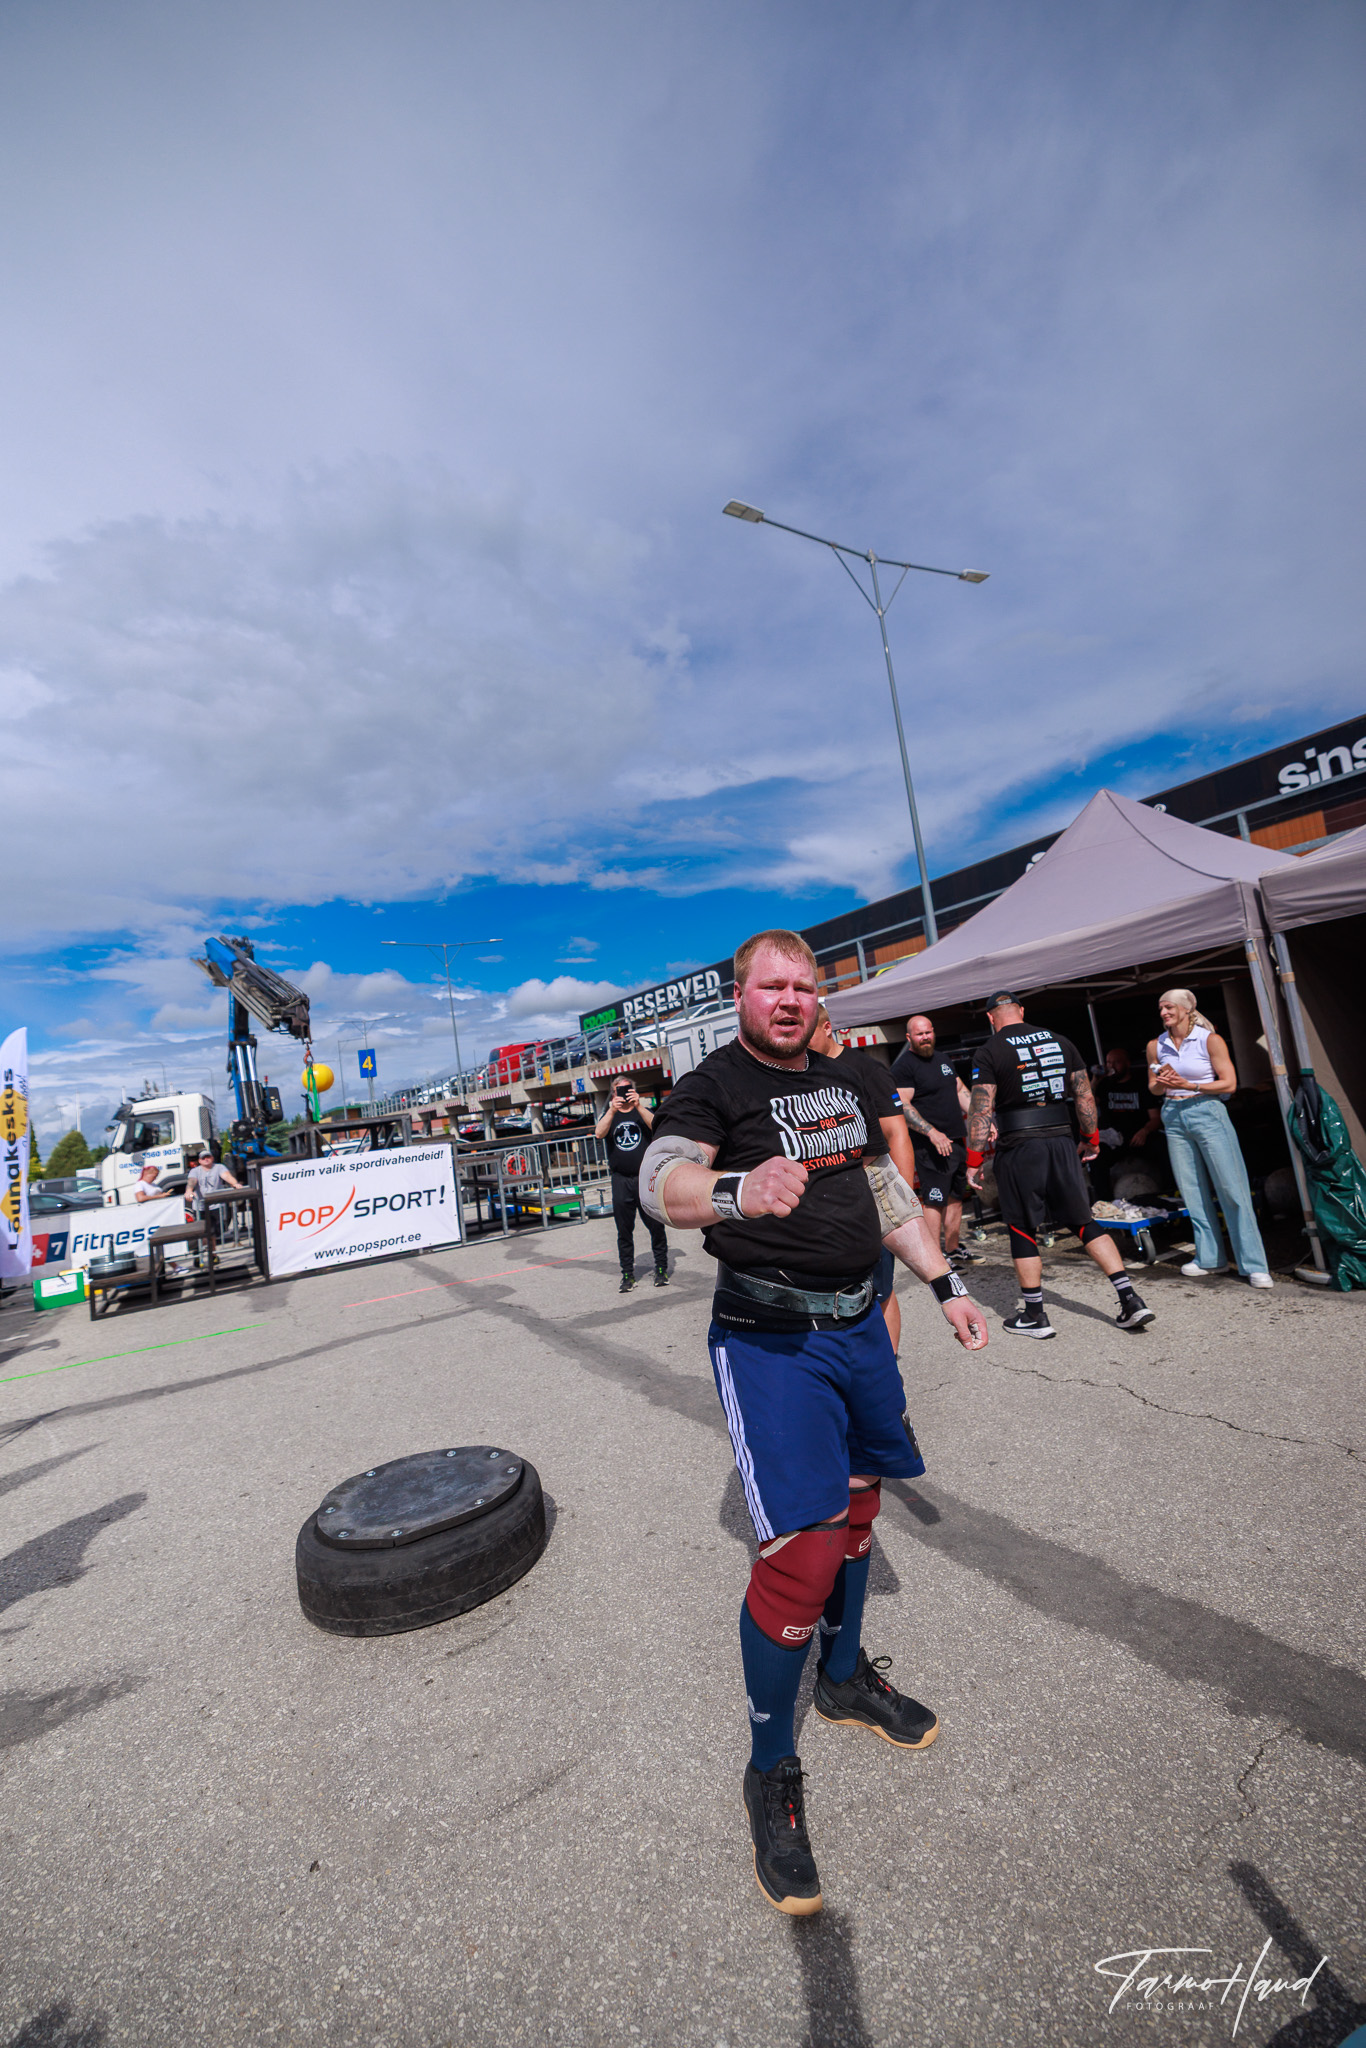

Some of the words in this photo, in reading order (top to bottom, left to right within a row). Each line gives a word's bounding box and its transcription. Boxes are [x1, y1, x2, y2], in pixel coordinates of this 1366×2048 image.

[623, 970, 721, 1023] RESERVED
[1006, 1030, 1053, 1046] VAHTER
[362, 1055, 374, 1071] 4
[820, 1117, 838, 1130] PRO
[271, 1168, 316, 1182] Suurim
[318, 1165, 347, 1176] valik
[349, 1149, 444, 1172] spordivahendeid!
[802, 1152, 847, 1171] ESTONIA
[278, 1205, 335, 1231] POP
[353, 1185, 446, 1219] SPORT!
[50, 1240, 64, 1256] 7
[314, 1232, 422, 1260] www.popsport.ee
[784, 1767, 799, 1776] TYR
